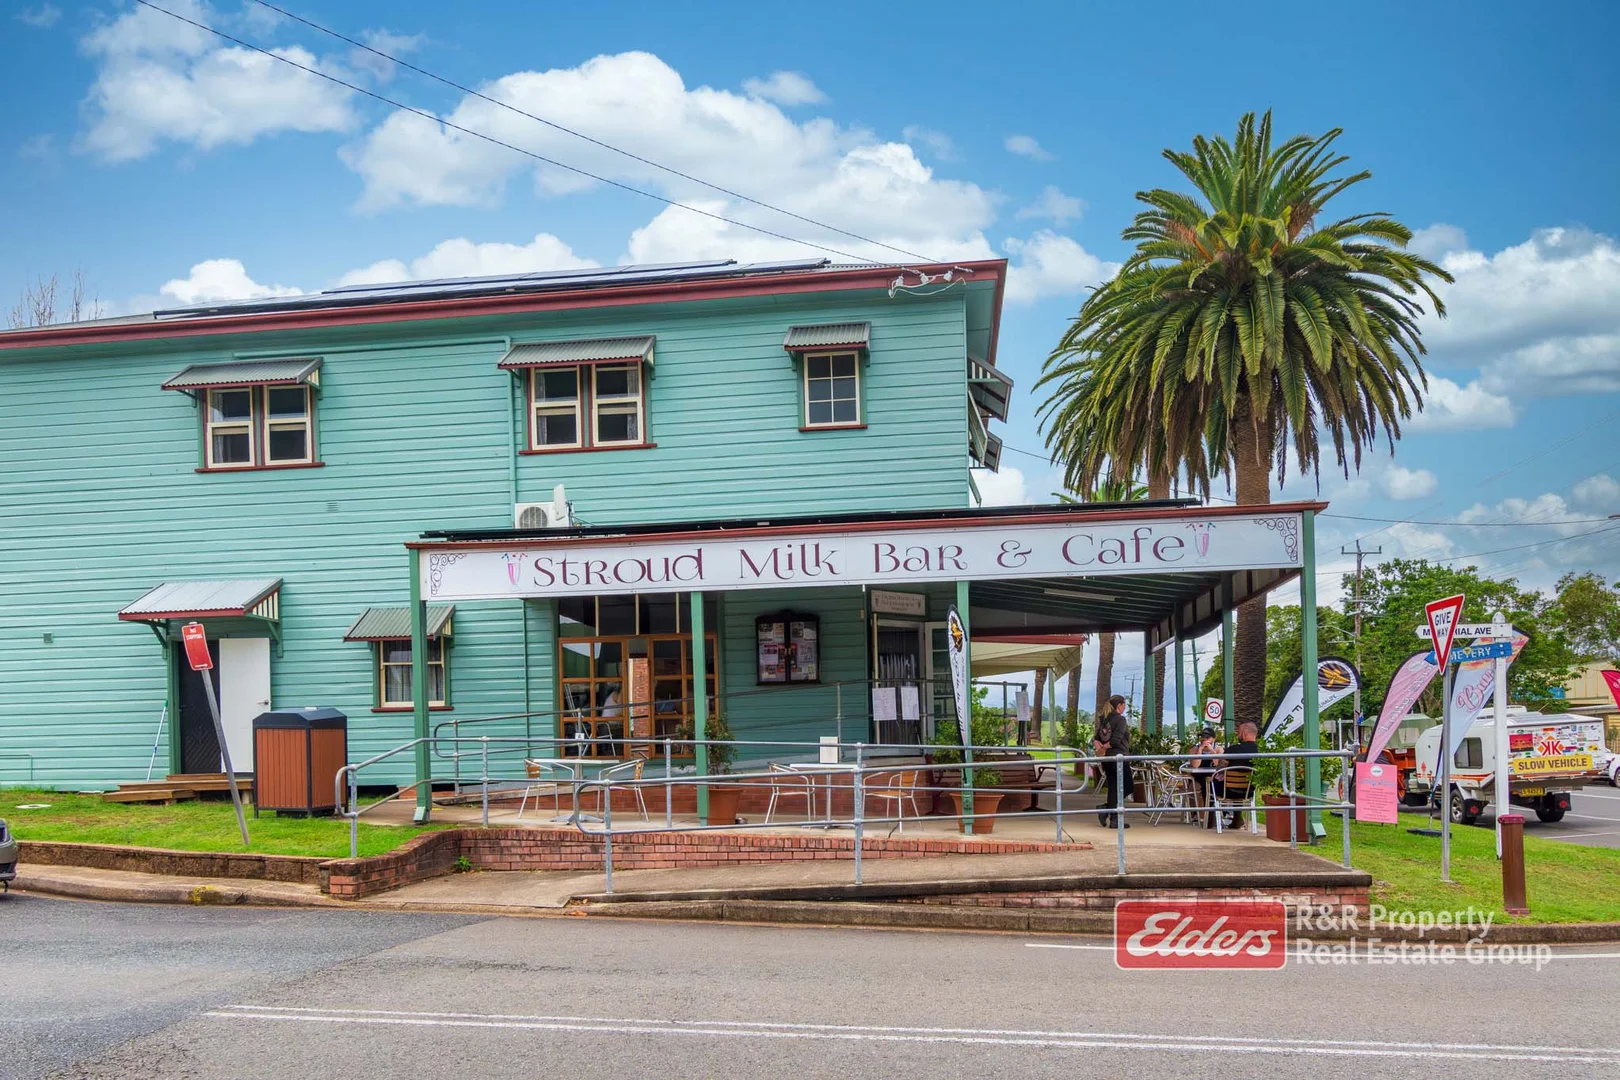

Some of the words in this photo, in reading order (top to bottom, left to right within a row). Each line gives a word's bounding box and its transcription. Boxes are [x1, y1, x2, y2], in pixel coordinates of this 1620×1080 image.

[533, 548, 704, 587] Stroud
[739, 542, 841, 580] Milk
[873, 541, 968, 573] Bar
[997, 539, 1032, 568] &
[1062, 526, 1185, 566] Cafe
[1435, 612, 1451, 626] GIVE
[1475, 627, 1491, 636] AVE
[1210, 706, 1219, 714] 50
[1518, 761, 1545, 770] SLOW
[1548, 758, 1587, 768] VEHICLE
